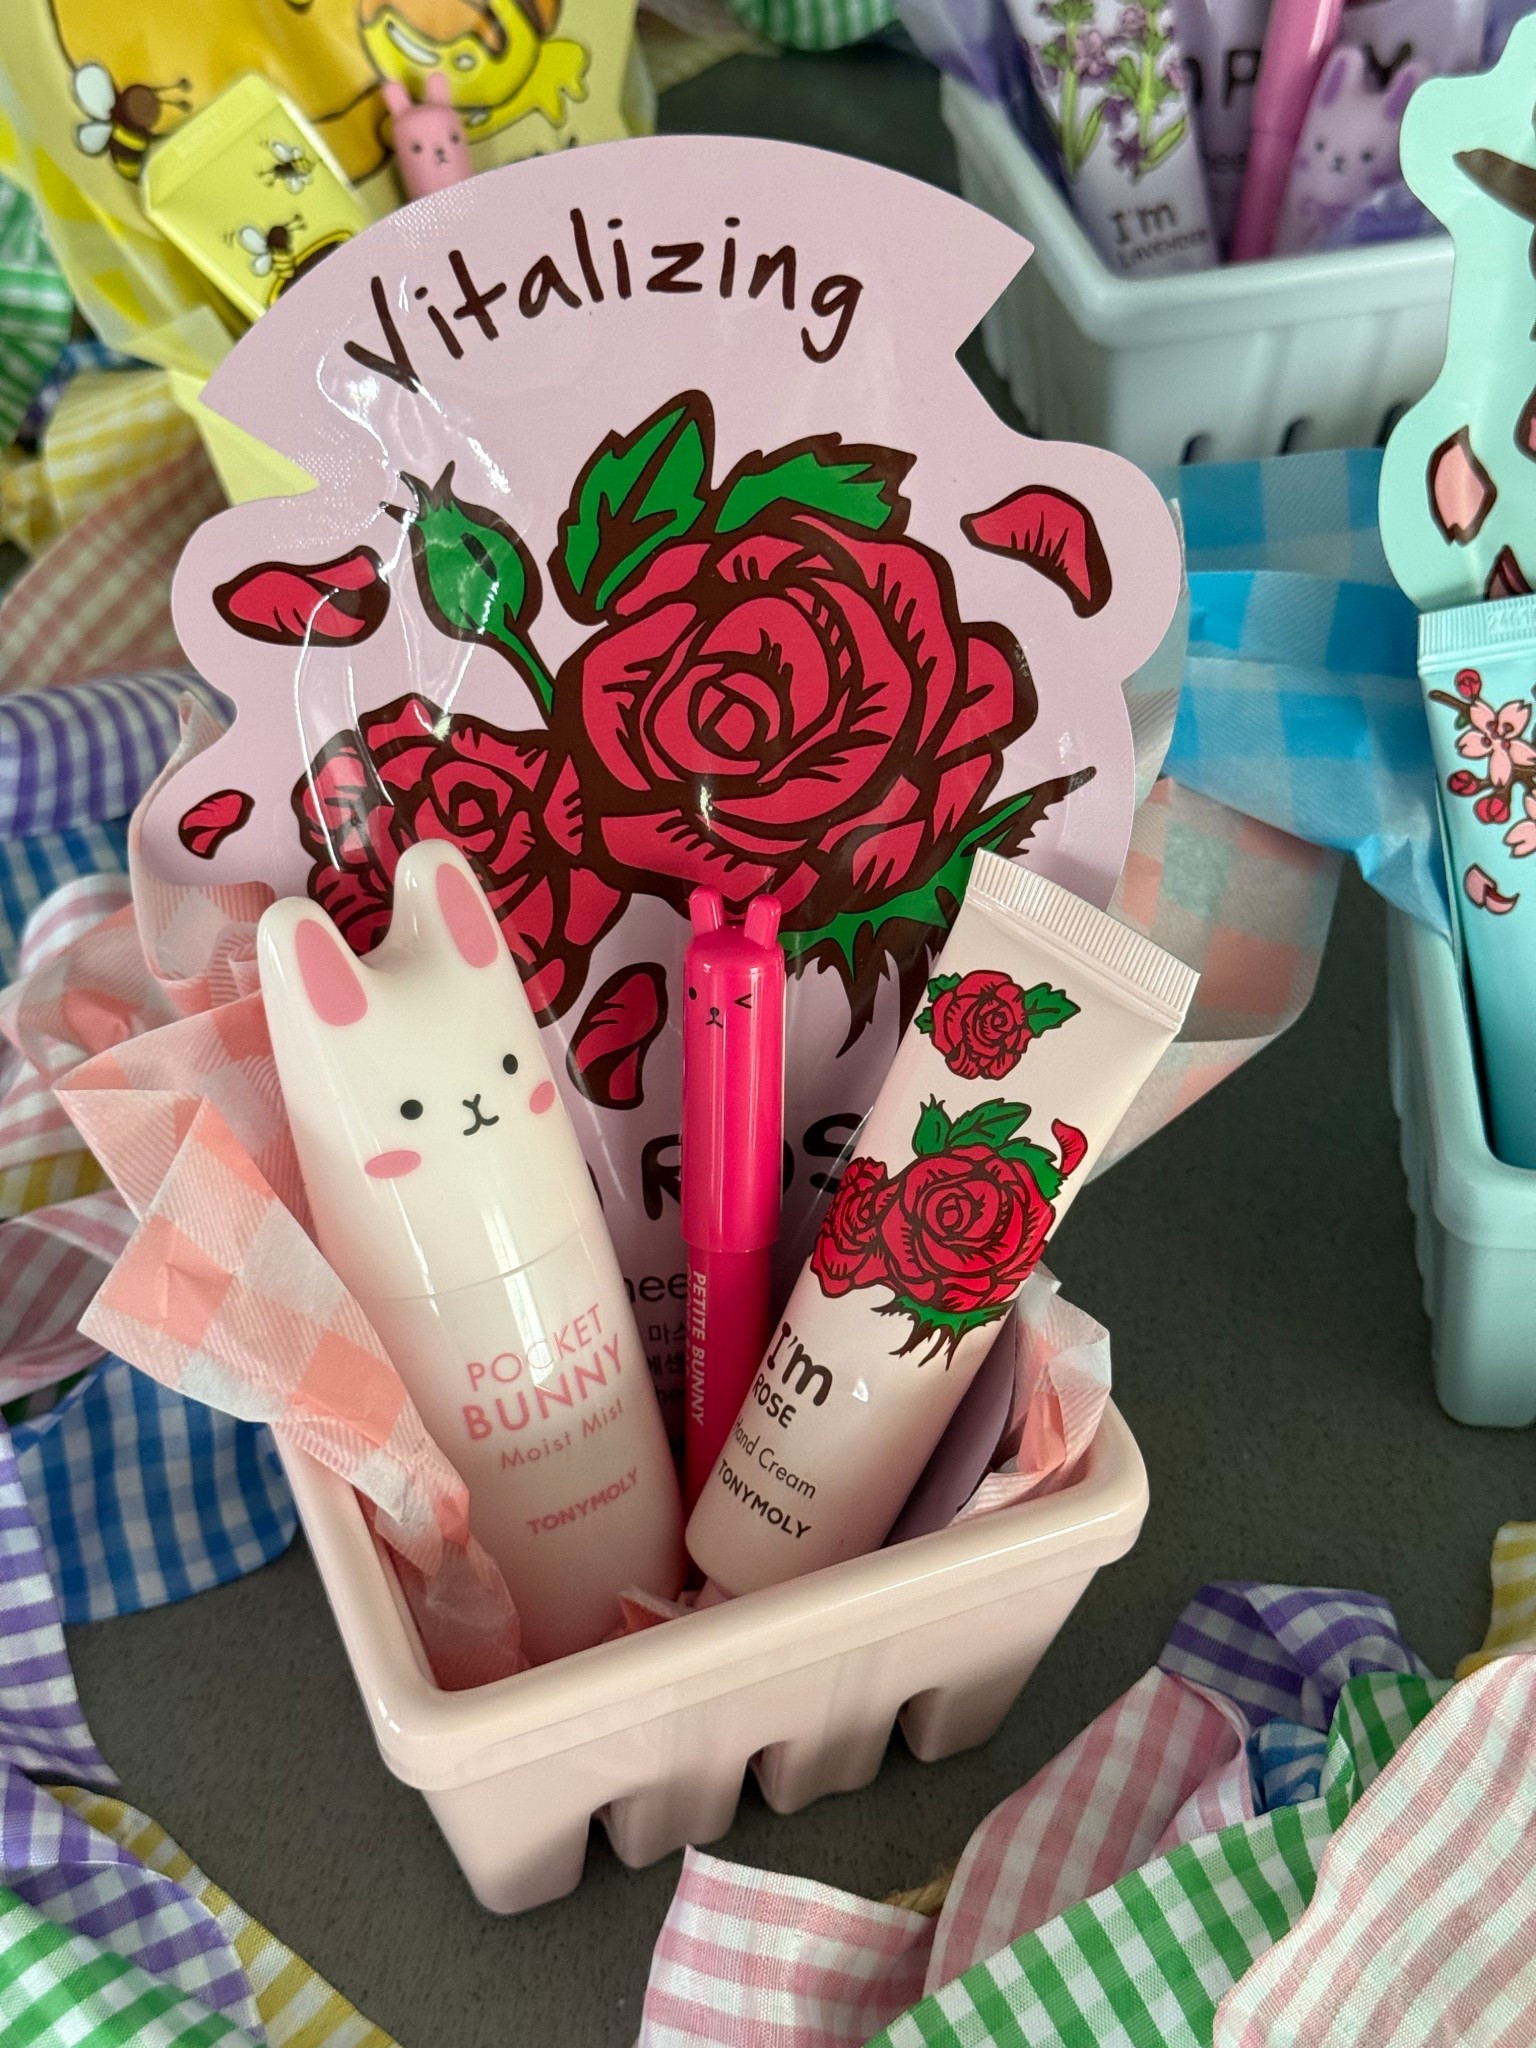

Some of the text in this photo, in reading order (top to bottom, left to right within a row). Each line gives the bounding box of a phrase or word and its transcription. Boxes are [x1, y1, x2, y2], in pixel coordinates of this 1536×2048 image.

[344, 208, 864, 393] Vitalizing
[463, 1332, 622, 1441] BUNNY
[466, 1302, 603, 1392] POCKET
[690, 1270, 707, 1427] PETITE BUNNY
[767, 1321, 833, 1407] I'm
[501, 1397, 624, 1470] Moist Mist
[752, 1372, 797, 1429] ROSE
[526, 1466, 639, 1535] TONYMOLY
[718, 1459, 812, 1539] TONYMOLY
[758, 1447, 817, 1499] Cream
